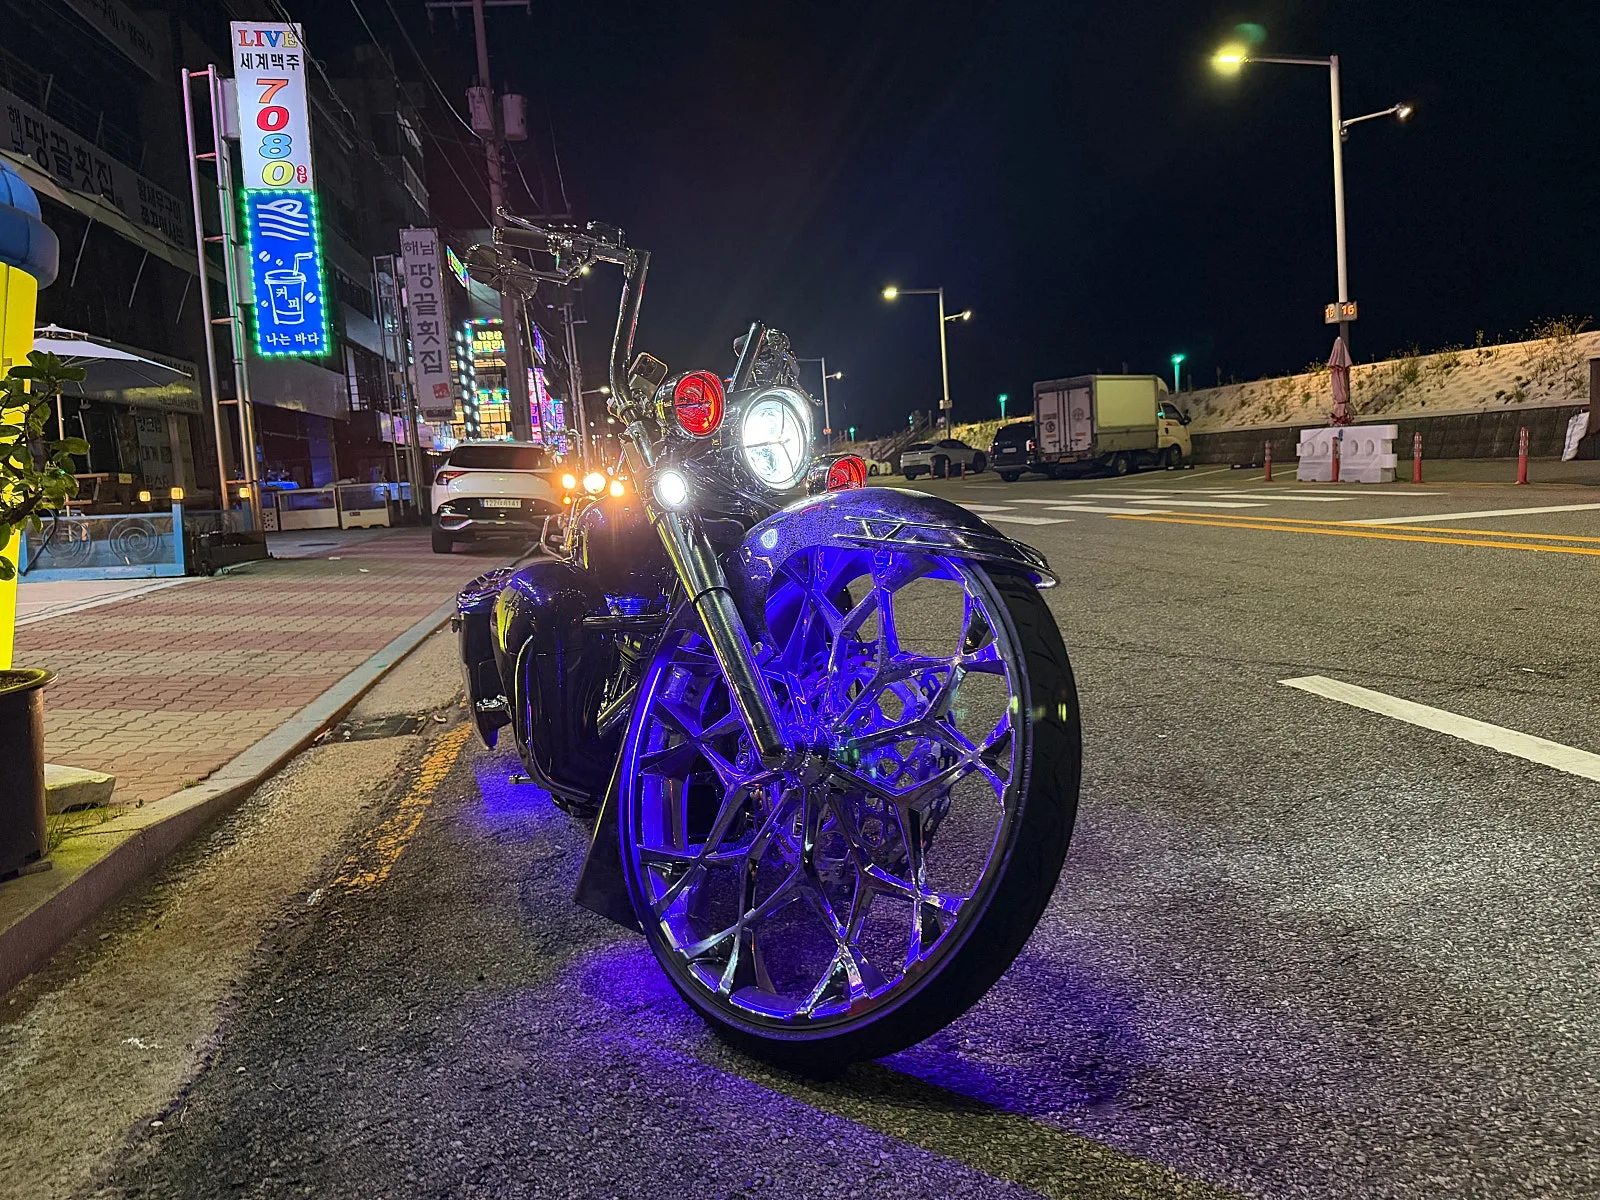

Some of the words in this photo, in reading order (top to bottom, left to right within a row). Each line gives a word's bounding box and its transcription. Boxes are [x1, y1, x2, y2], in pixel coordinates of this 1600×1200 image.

[238, 29, 298, 48] LIVE
[240, 52, 300, 71] 세계맥주
[256, 78, 295, 187] 7080
[297, 166, 307, 183] 3F
[403, 240, 436, 256] 해남
[275, 286, 300, 311] 커피
[409, 262, 443, 375] 땅끝횟집
[1341, 304, 1356, 315] 16
[266, 332, 291, 346] 나는
[295, 332, 320, 346] 바다
